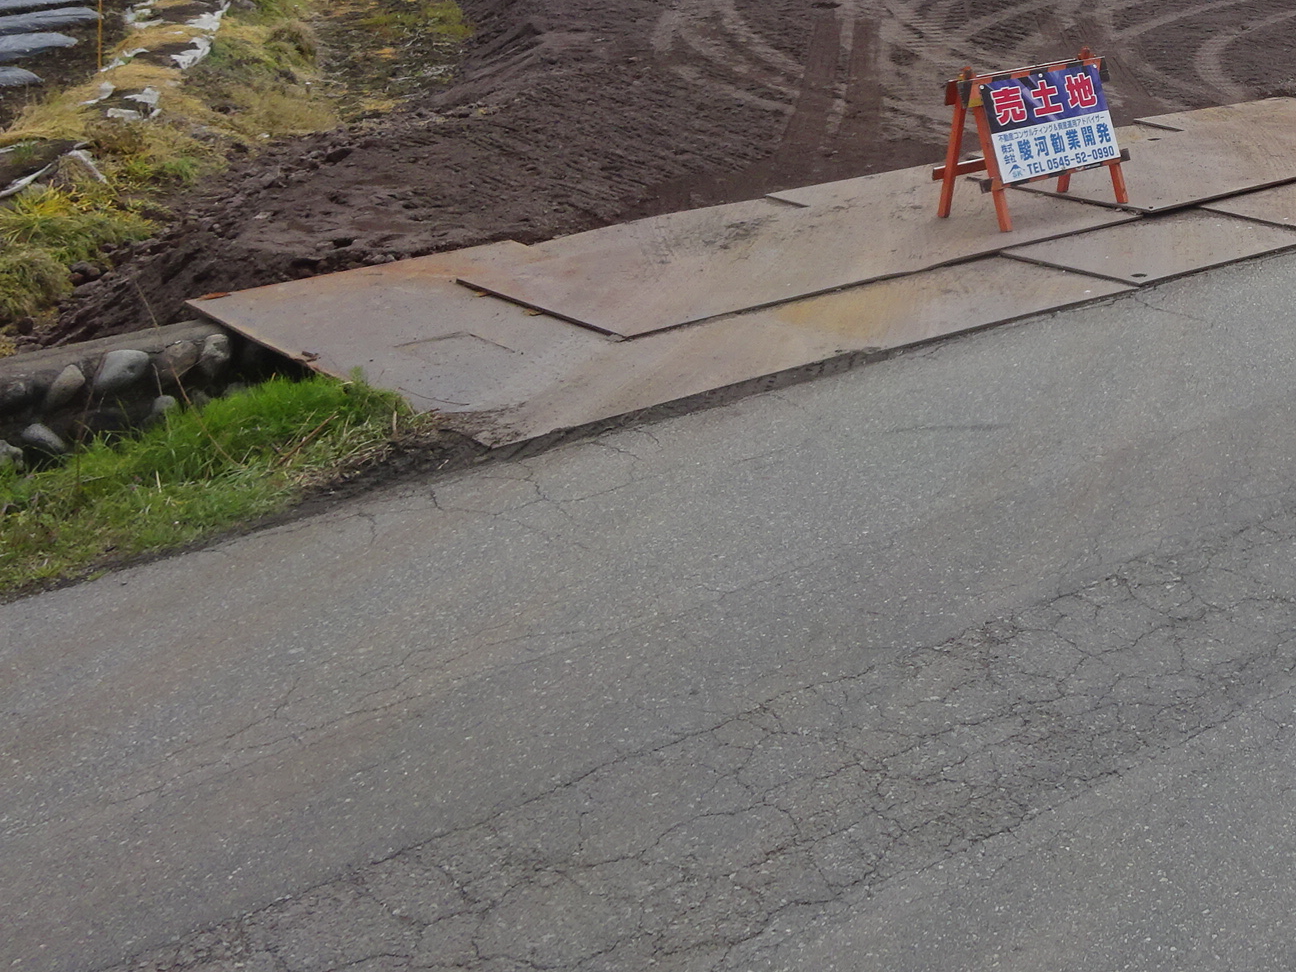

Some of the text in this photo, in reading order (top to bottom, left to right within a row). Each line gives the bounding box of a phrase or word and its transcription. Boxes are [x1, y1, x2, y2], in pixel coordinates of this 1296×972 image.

[991, 73, 1098, 126] 売土地
[1027, 145, 1115, 174] TEL 0545-52-0990
